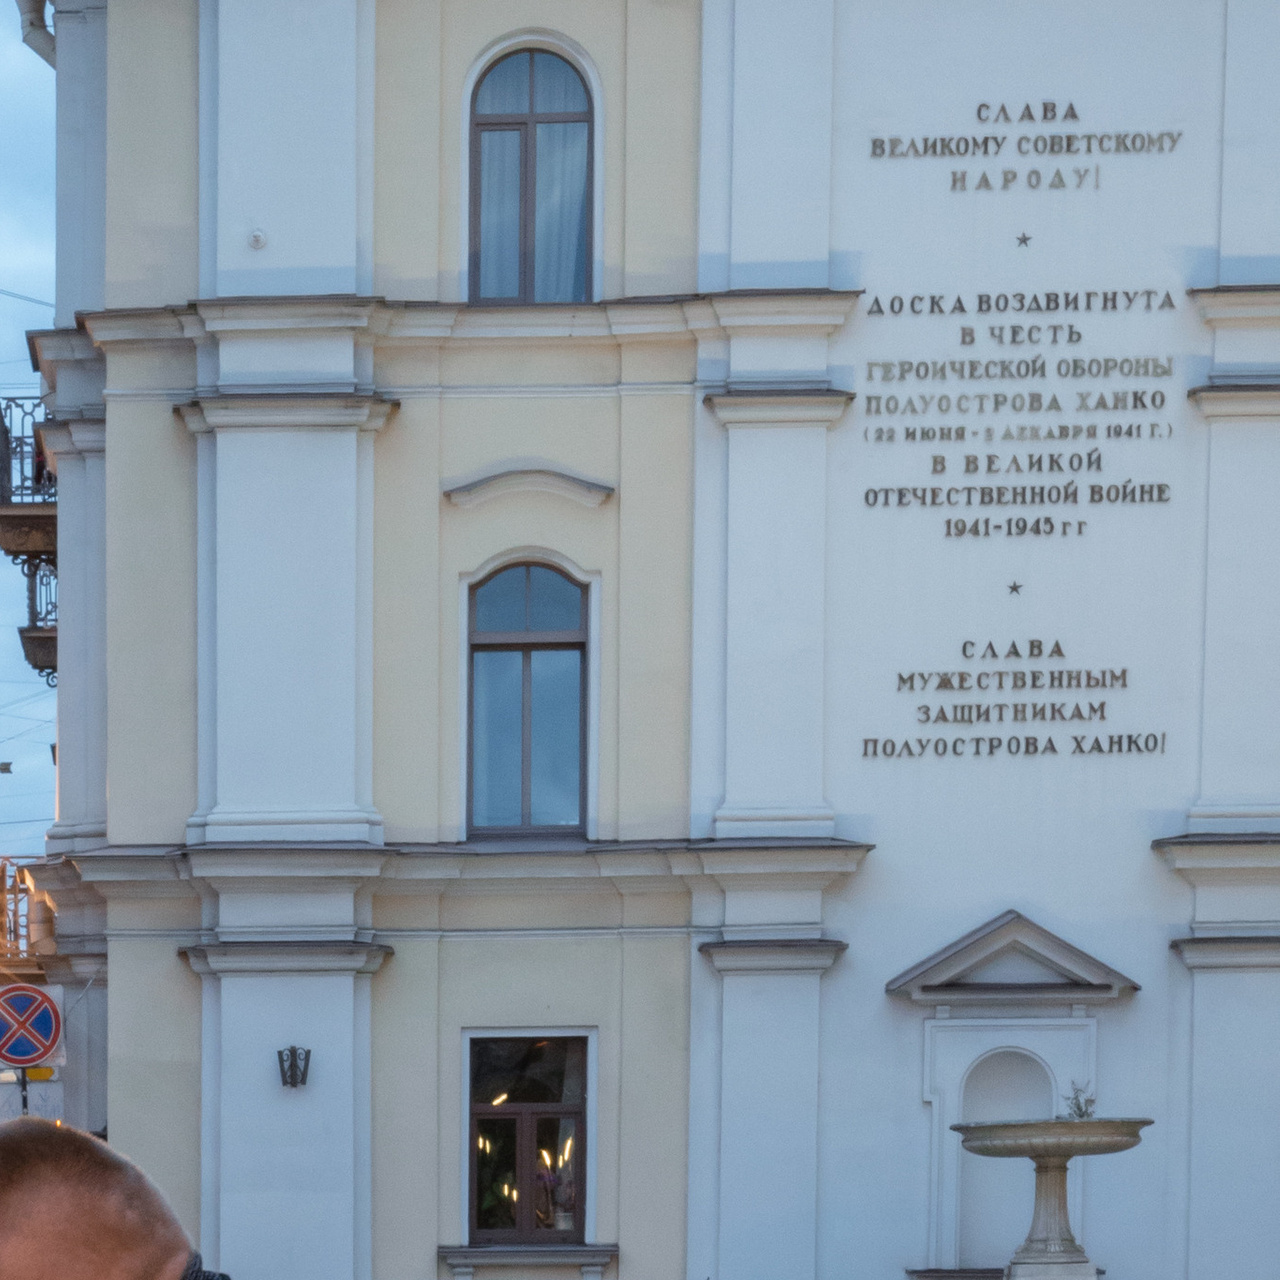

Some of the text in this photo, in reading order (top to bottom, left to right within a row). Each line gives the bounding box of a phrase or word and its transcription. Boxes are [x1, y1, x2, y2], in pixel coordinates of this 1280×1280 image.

[975, 101, 1081, 125] СЛАВА
[869, 131, 1184, 160] ВЕЛИКОМУ СОВЕТСКОМУ
[949, 166, 1101, 193] НАРОДУ!
[866, 289, 1177, 317] ДОСКА ВОЗДВИГНУТА
[959, 324, 1083, 347] В ЧЕСТЬ
[866, 354, 1174, 382] ГЕРОИЧЕСКОЙ ОБОРОНЫ
[864, 390, 1166, 416] ПОЛУОСТРОВА ХАНКО
[903, 426, 968, 443] ИЮНЯ
[1105, 424, 1142, 441] 1941
[930, 447, 1103, 475] В ВЕЛИКОЙ
[863, 478, 1172, 509] ОТЕЧЕСТВЕННОЙ ВОЙНЕ
[943, 517, 1056, 539] 1941-1945
[960, 639, 1067, 660] СЛАВА
[896, 668, 1129, 694] МУЖЕСТВЕННЫМ
[916, 701, 1107, 726] ЗАЩИТНИКАМ
[861, 732, 1168, 760] ПОЛУОСТРОВА ХАНКО!
